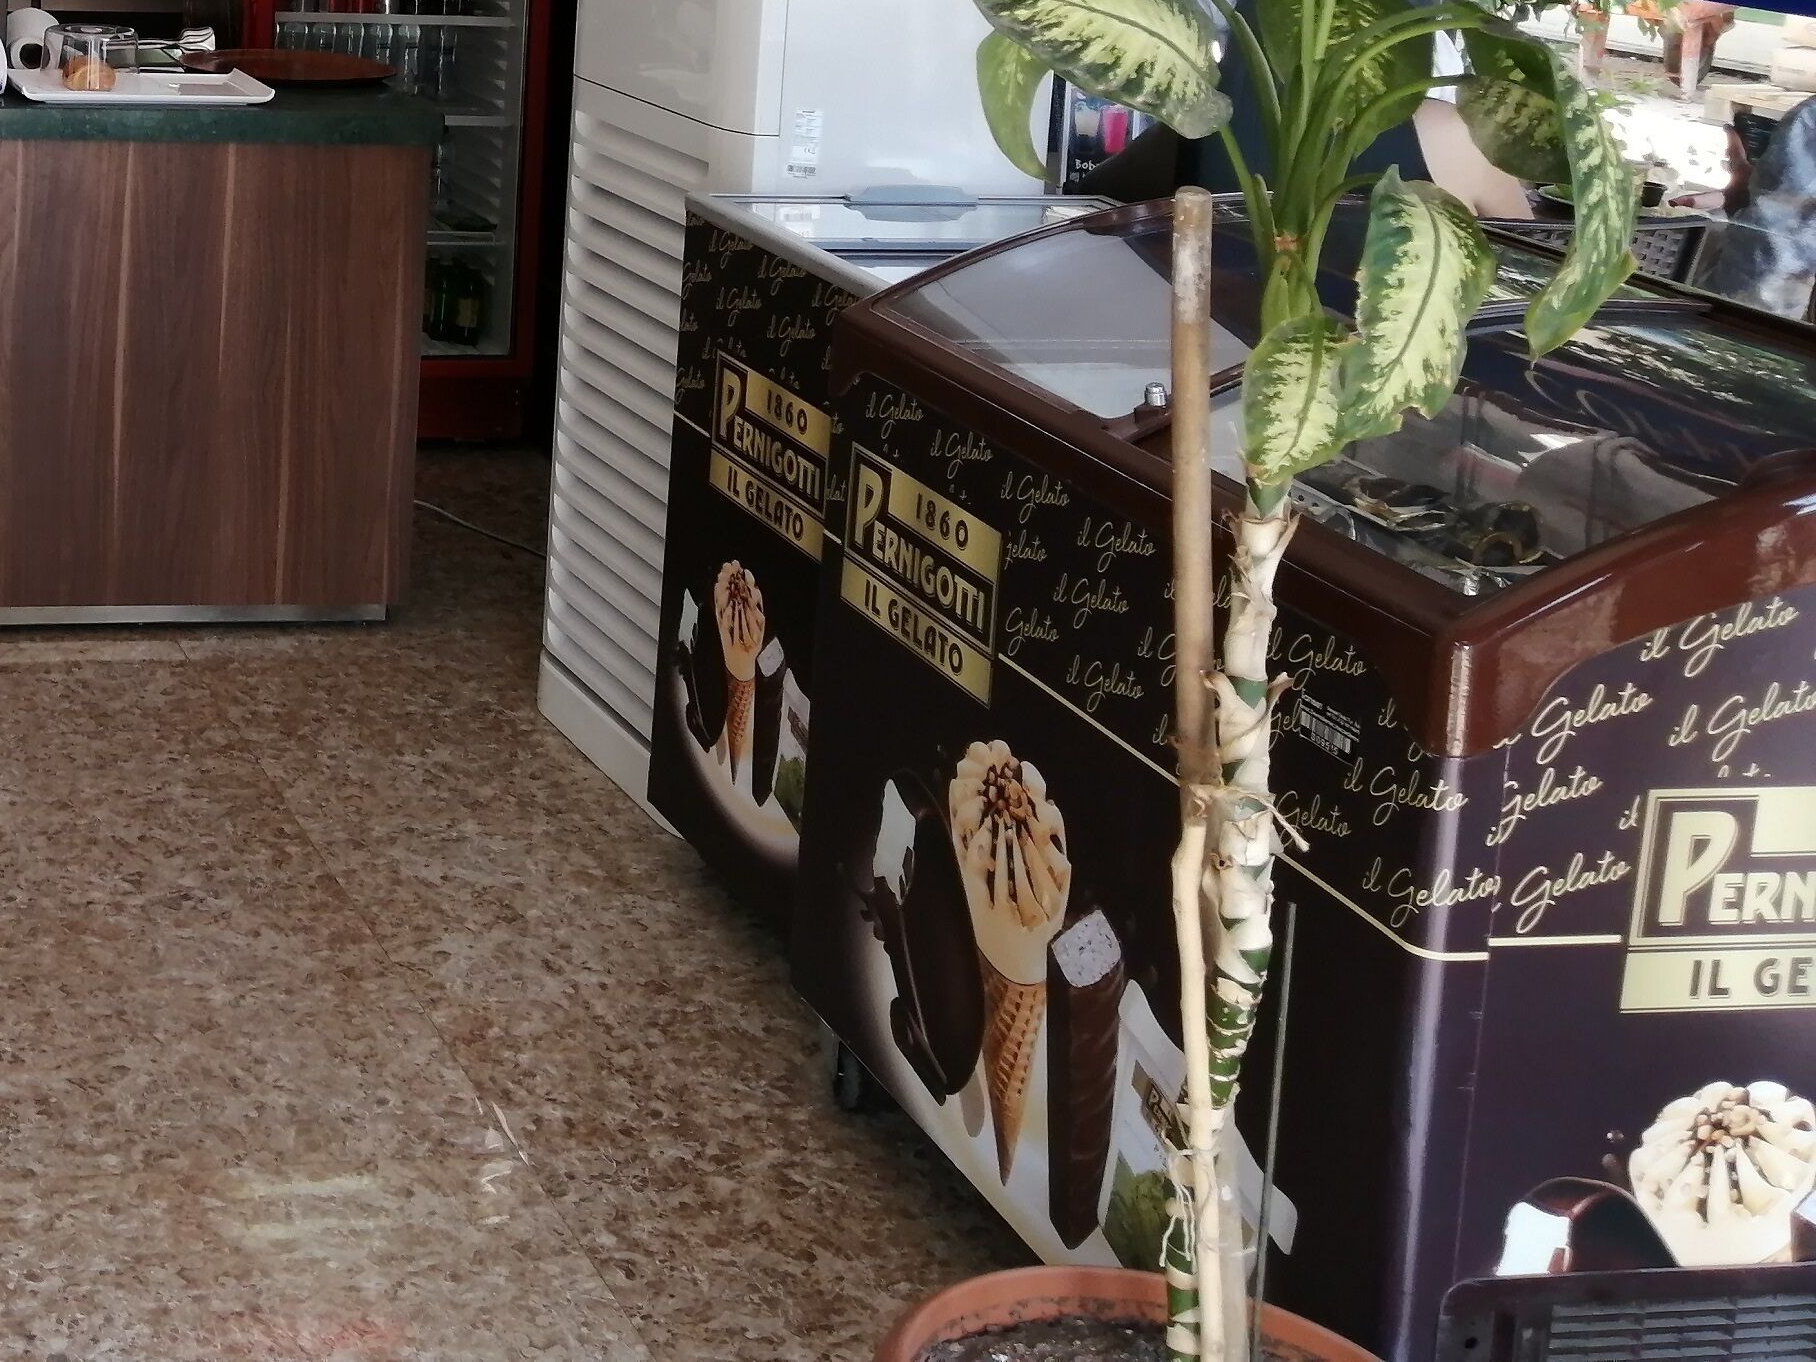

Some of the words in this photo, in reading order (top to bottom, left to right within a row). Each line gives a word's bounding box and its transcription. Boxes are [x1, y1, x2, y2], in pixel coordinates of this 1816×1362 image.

[1075, 158, 1100, 171] Bob
[719, 366, 822, 501] PERNIGOTTI
[767, 389, 809, 436] 1860
[879, 392, 924, 440] Gelato
[945, 431, 994, 480] Gelato
[727, 464, 741, 499] IL
[745, 479, 805, 542] GELATO
[916, 492, 969, 551] 1860
[1017, 474, 1071, 524] Gelato
[854, 463, 985, 634] PERNIGOTTI
[1094, 521, 1157, 573] Gelato
[864, 578, 881, 619] IL
[887, 598, 964, 676] GELATO
[1005, 607, 1060, 657] Gelato
[1071, 578, 1129, 630] Gelato
[1288, 633, 1366, 691] Gelato
[1639, 627, 1671, 663] il
[1678, 595, 1800, 678] Gelato
[1084, 660, 1145, 713] Gelato
[1531, 682, 1654, 765] Gelato
[1668, 704, 1699, 747] il
[1707, 679, 1816, 762] Gelato
[1276, 791, 1352, 848] Gelato
[1343, 756, 1364, 792] il
[1369, 766, 1470, 826] Gelato
[1362, 857, 1382, 892] il
[1387, 867, 1498, 928] Gelato
[1510, 850, 1633, 935] Gelato
[1689, 959, 1730, 999] IL
